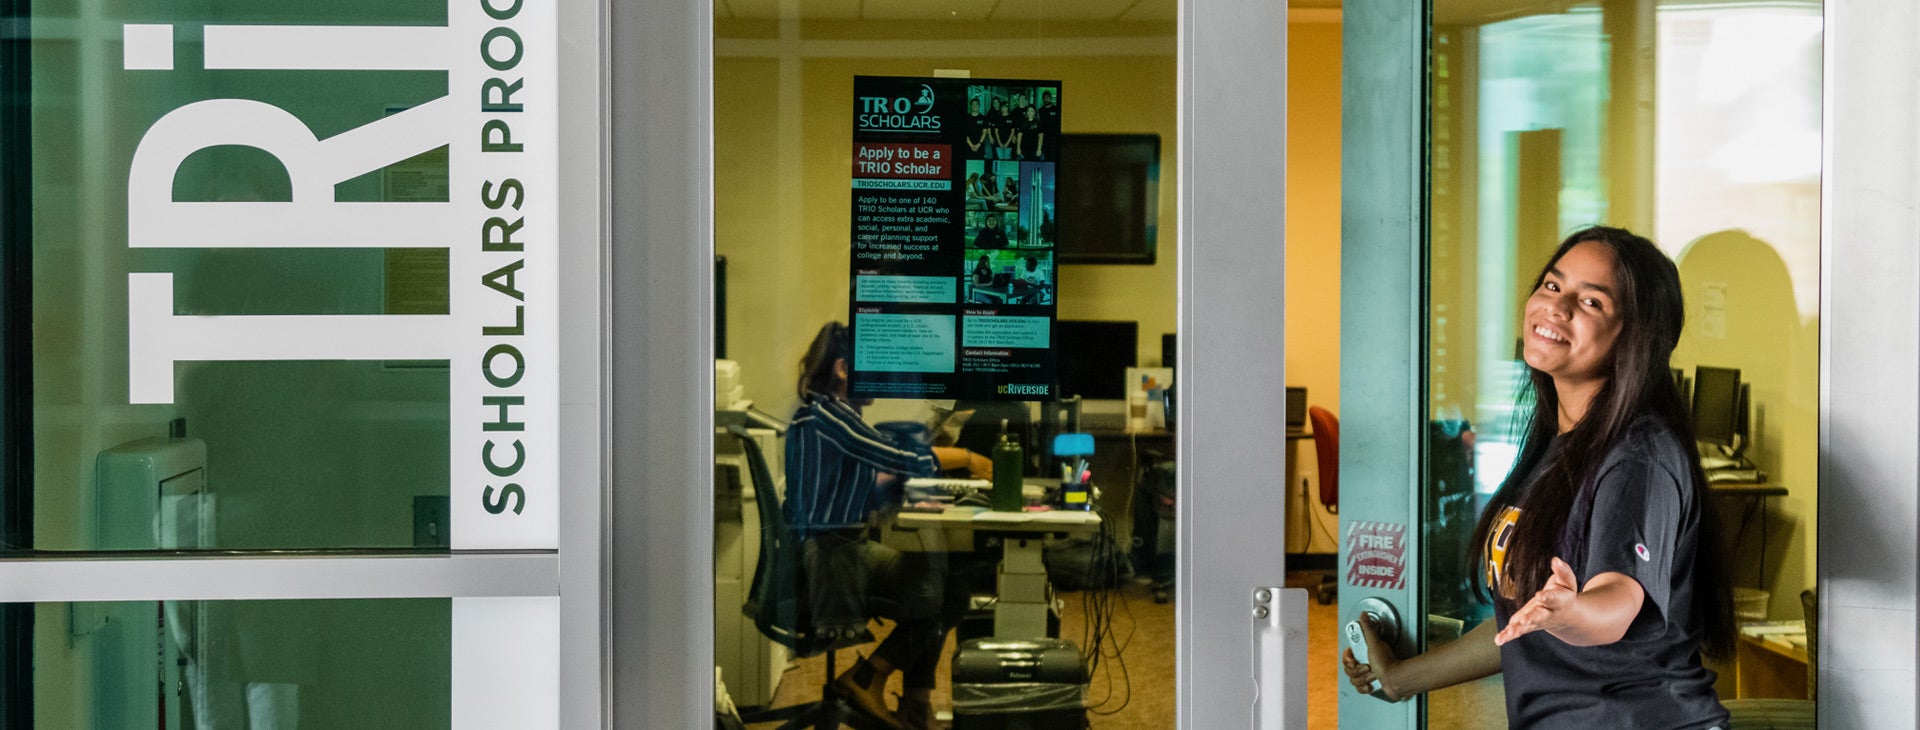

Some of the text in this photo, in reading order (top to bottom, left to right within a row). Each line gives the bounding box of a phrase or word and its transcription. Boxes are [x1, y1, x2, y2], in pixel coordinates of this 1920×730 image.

[859, 114, 941, 129] SCHOLARS
[859, 146, 941, 160] Apply to be a
[859, 161, 941, 175] TRIO Scholar
[857, 181, 945, 189] TRIOSCHOLARS.UCR.EDU
[858, 196, 878, 204] Apply
[879, 196, 887, 204] to
[888, 196, 897, 204] be
[917, 206, 933, 214] UCR
[915, 216, 951, 224] academic,
[880, 234, 911, 242] planning
[869, 242, 901, 250] increased
[857, 252, 881, 260] college
[482, 177, 525, 515] SCHOLARS
[1360, 535, 1394, 549] FIRE
[1359, 565, 1395, 577] INSIDE
